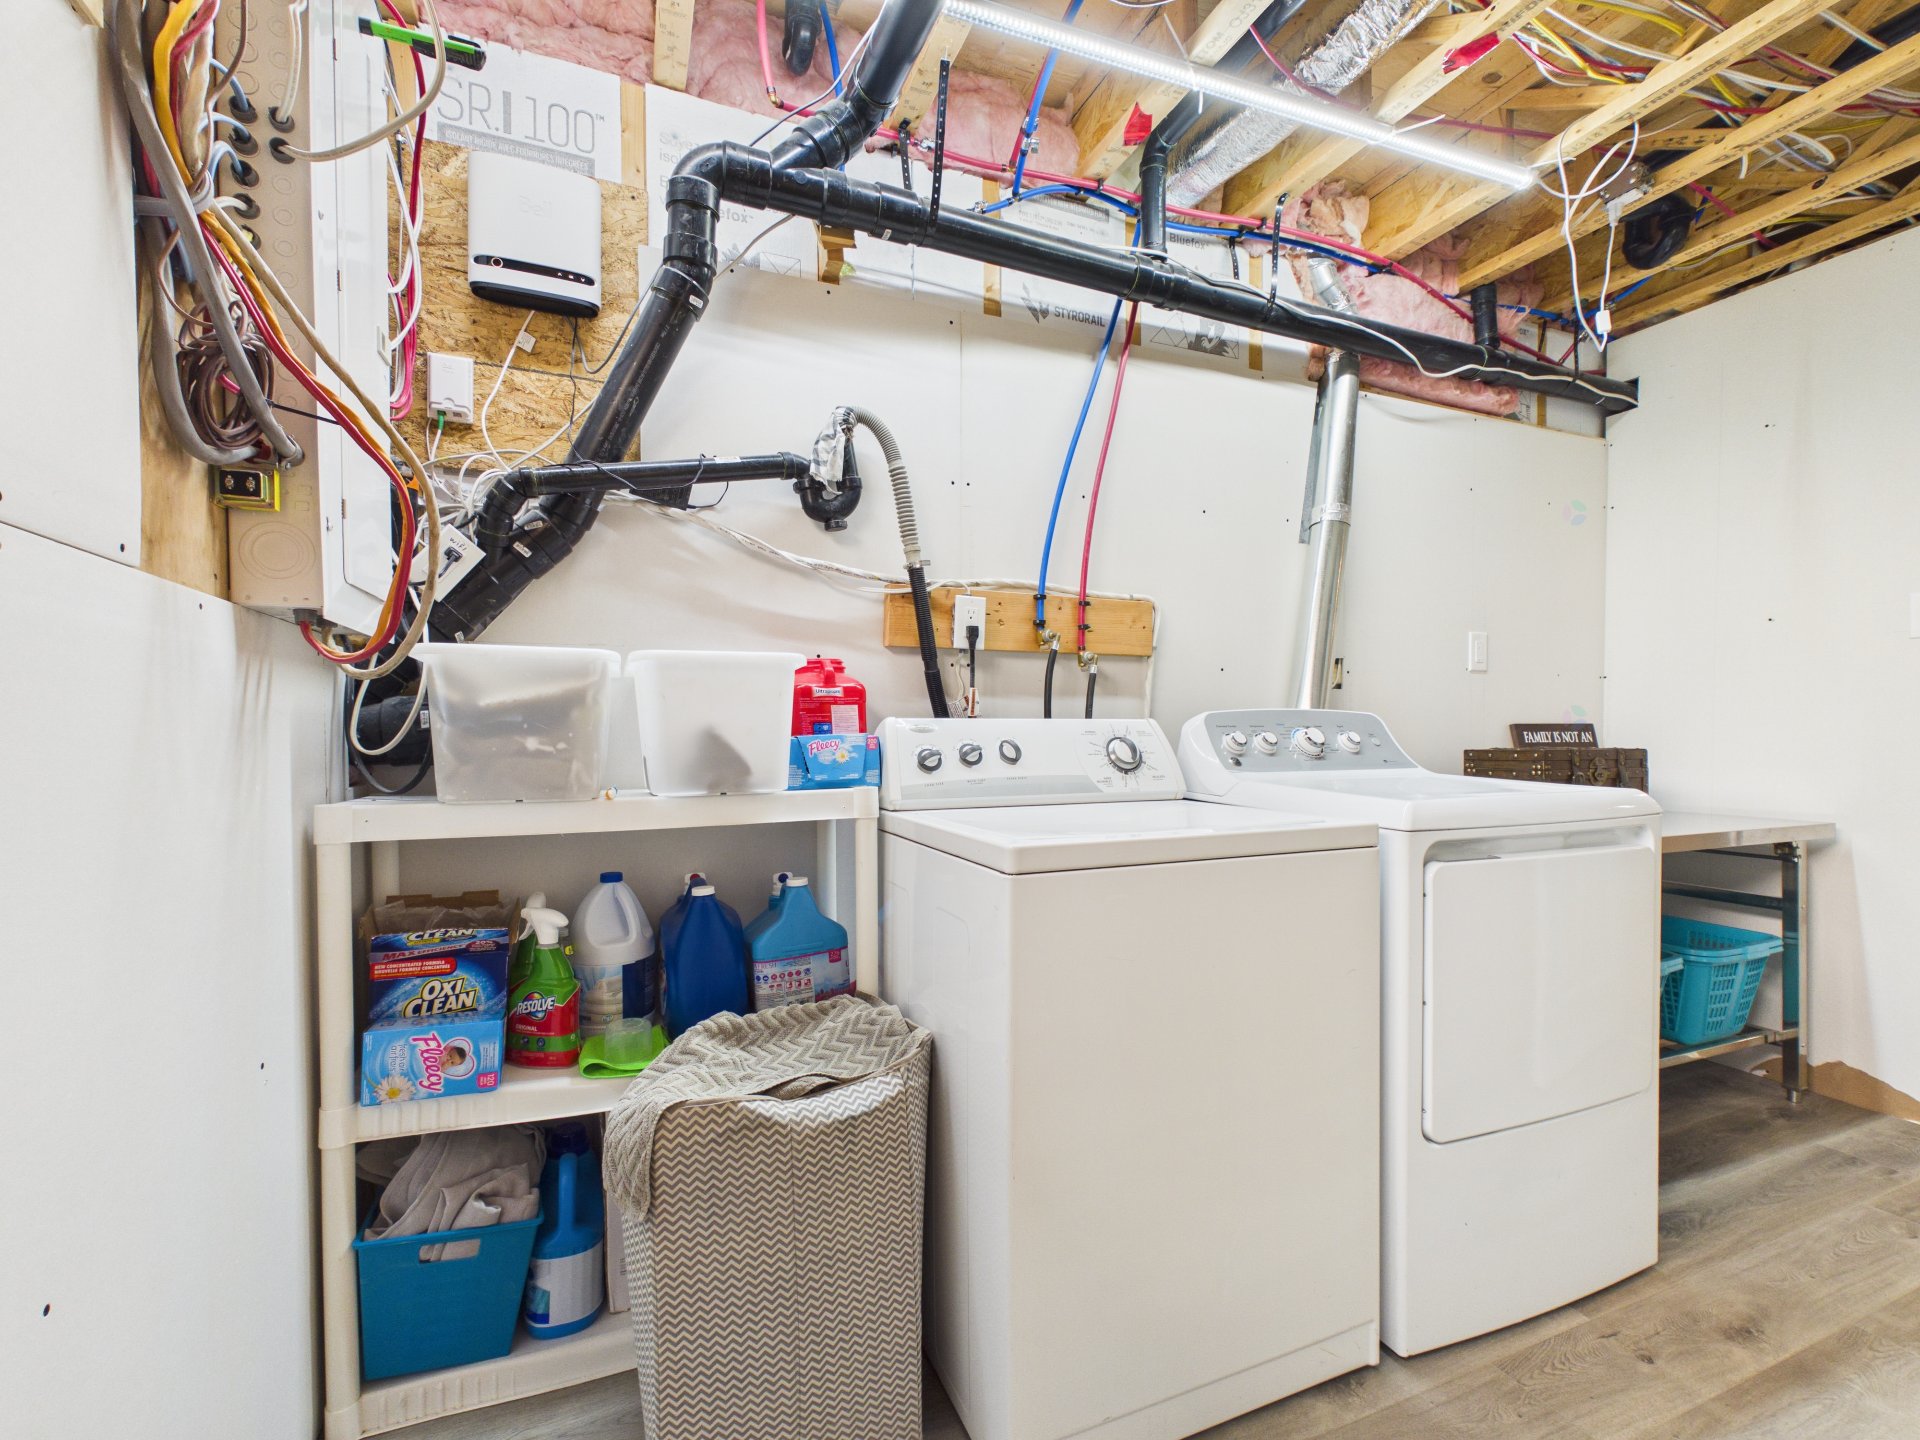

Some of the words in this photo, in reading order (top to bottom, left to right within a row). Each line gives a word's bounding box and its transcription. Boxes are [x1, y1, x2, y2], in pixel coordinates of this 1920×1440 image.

[1054, 306, 1106, 328] STYRORAIL
[1523, 731, 1553, 744] FAMILY
[1553, 731, 1561, 743] IS
[1562, 731, 1580, 743] NOT
[1581, 731, 1594, 743] AN
[808, 738, 841, 758] Fleecy
[382, 950, 416, 961] MAX
[421, 978, 466, 1001] OXI
[403, 990, 478, 1018] CLEAN
[516, 996, 556, 1016] RESOLVE
[411, 1032, 444, 1093] Fleecy
[486, 1073, 495, 1087] 120
